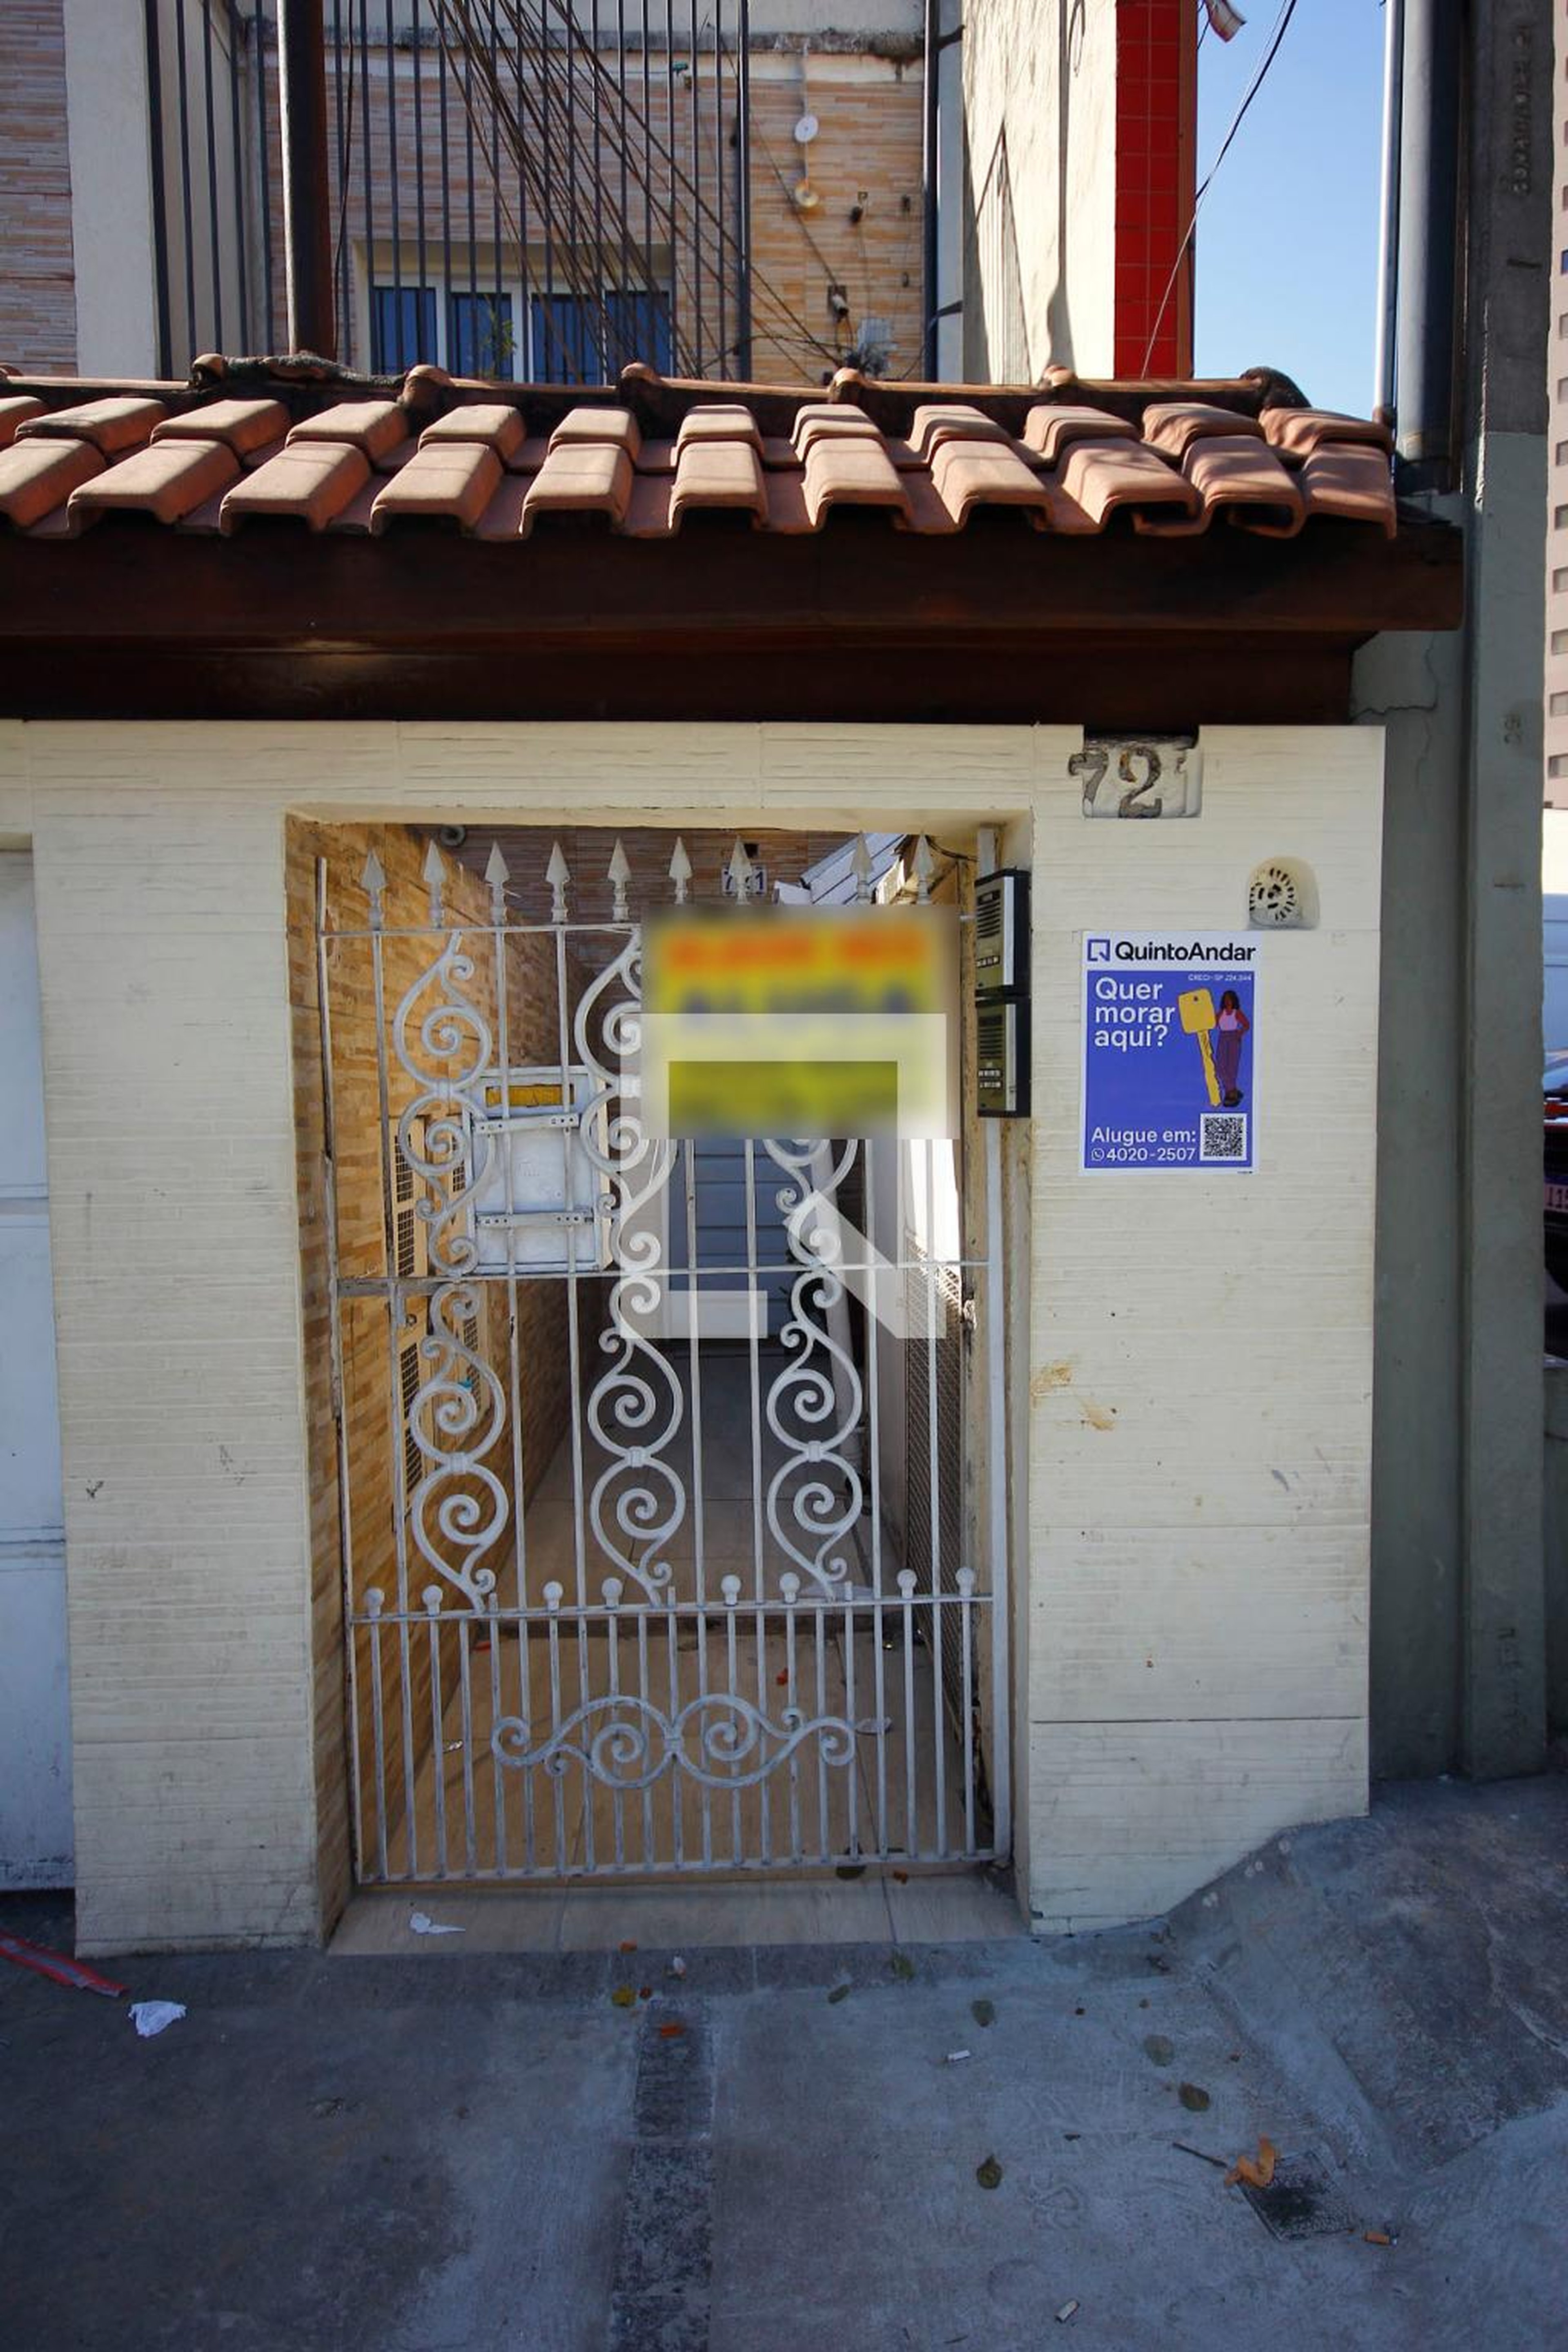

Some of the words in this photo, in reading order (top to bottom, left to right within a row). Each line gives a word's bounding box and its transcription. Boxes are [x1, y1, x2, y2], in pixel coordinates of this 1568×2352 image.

[724, 871, 763, 890] 71
[1115, 941, 1256, 961] QuintoAndar
[1096, 977, 1163, 1000] Quer
[1096, 1007, 1175, 1024] morar
[1095, 1025, 1168, 1052] aqui?
[1091, 1127, 1157, 1146] Alugue
[1163, 1131, 1196, 1143] em:
